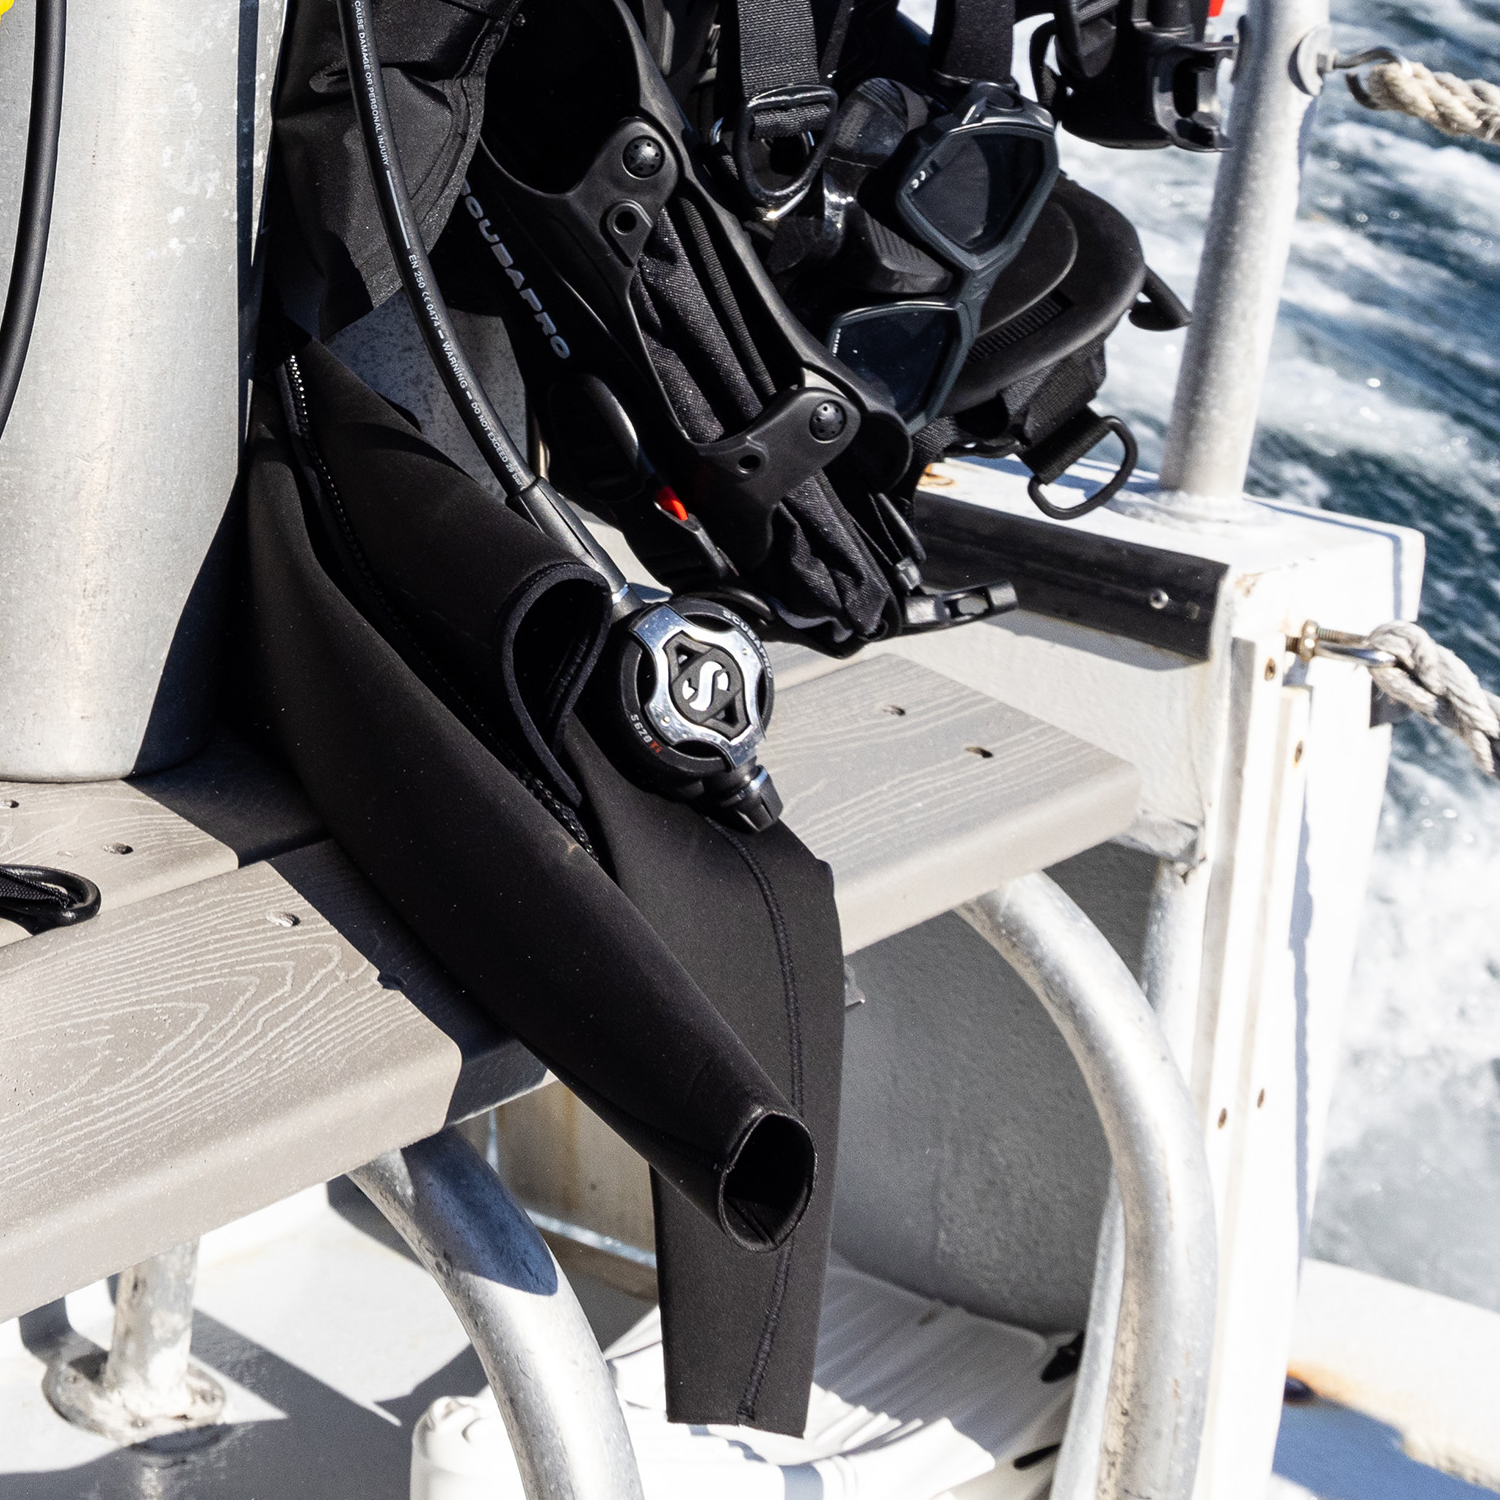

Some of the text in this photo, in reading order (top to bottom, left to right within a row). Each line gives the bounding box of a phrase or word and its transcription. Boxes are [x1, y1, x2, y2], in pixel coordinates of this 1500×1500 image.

[354, 0, 365, 30] CAUSE
[358, 32, 371, 69] DAMAGE
[365, 71, 373, 89] OR
[367, 89, 381, 134] PERSONAL
[376, 134, 390, 166] INJURY
[408, 254, 419, 269] EN
[414, 270, 426, 290] 250
[426, 303, 441, 328] 0474
[442, 341, 468, 390] WARNING
[470, 401, 481, 416] DO
[478, 414, 491, 432] NOT
[487, 431, 509, 465] EXCEED
